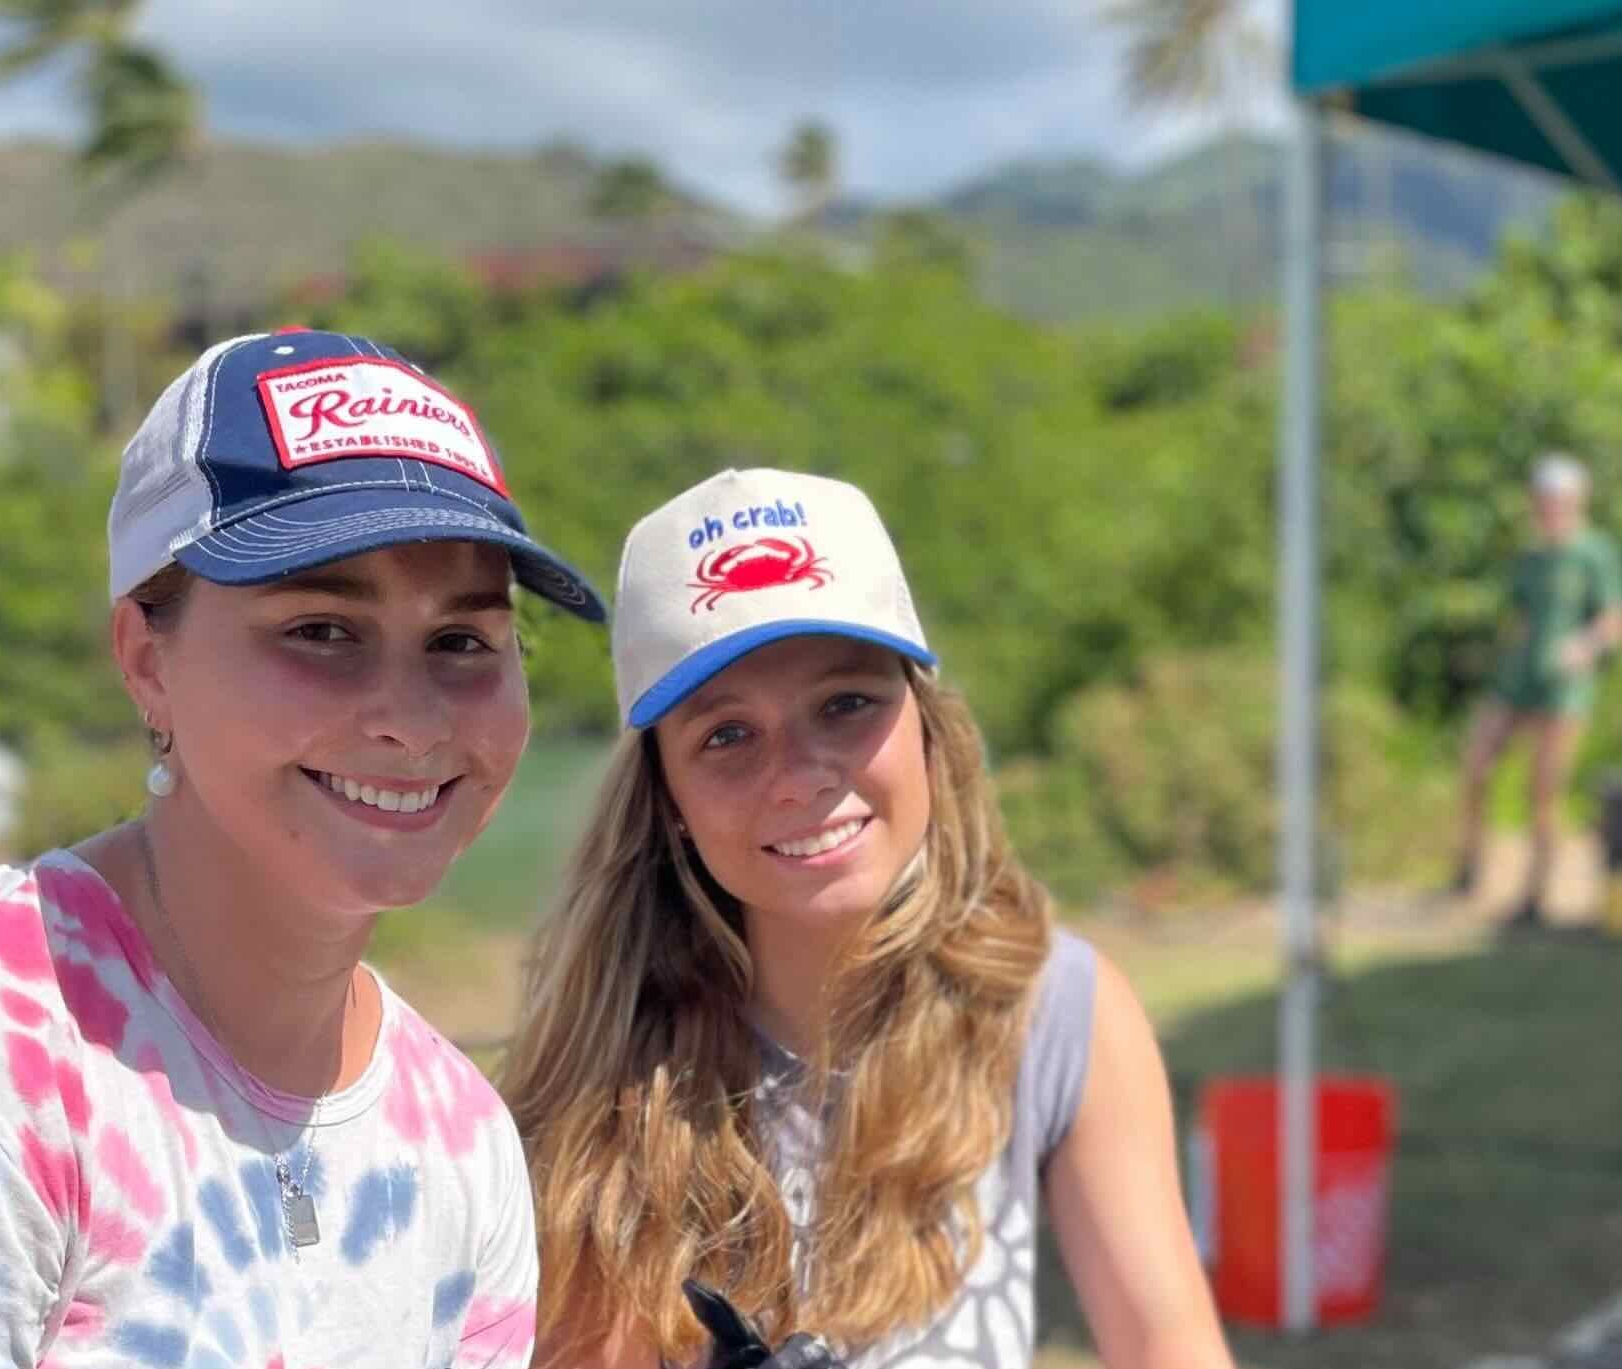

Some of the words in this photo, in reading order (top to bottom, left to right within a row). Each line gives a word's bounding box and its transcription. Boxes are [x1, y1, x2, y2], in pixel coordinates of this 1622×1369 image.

[275, 372, 347, 393] TACOMA
[309, 434, 440, 453] ESTABLISHED
[689, 516, 724, 549] oh
[732, 499, 807, 529] crab!
